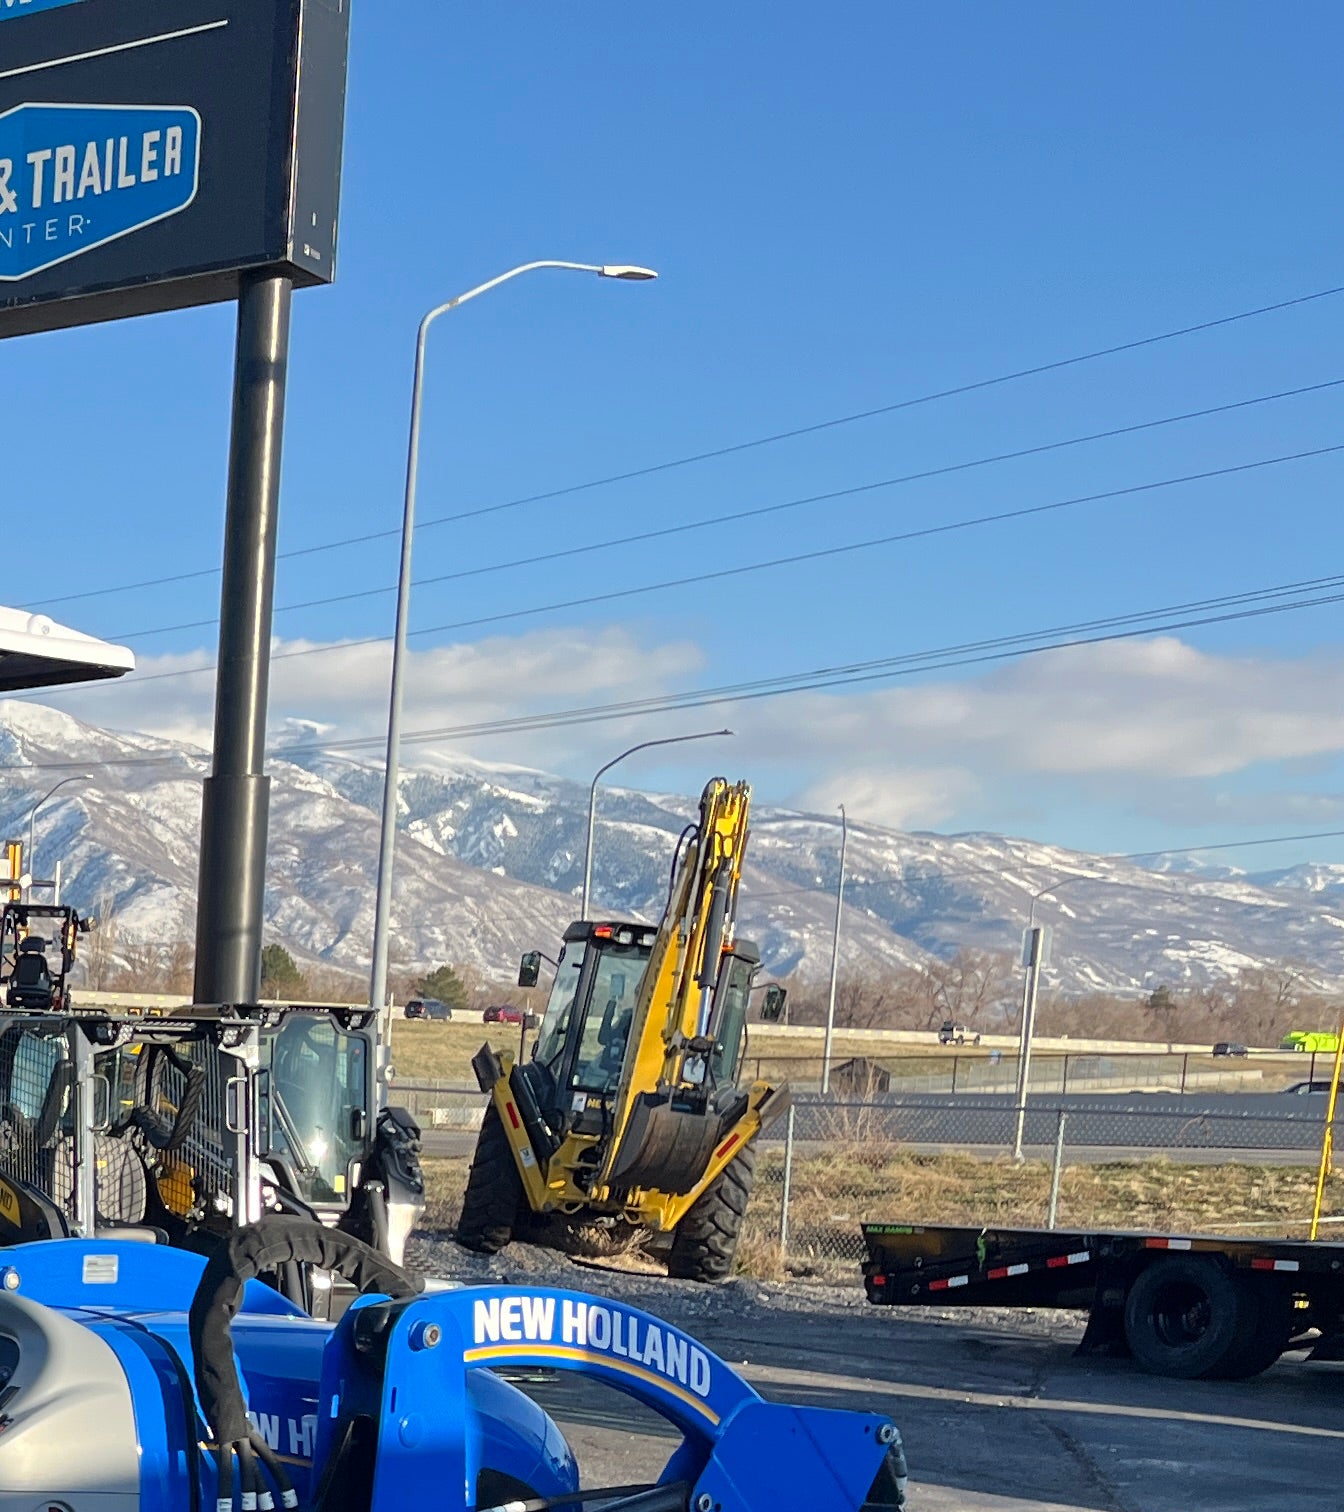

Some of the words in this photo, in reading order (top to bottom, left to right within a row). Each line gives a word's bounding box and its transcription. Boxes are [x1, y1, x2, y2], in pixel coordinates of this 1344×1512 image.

[26, 125, 182, 207] TRAILER
[473, 1296, 555, 1344] NEW
[562, 1299, 711, 1398] HOLLAND
